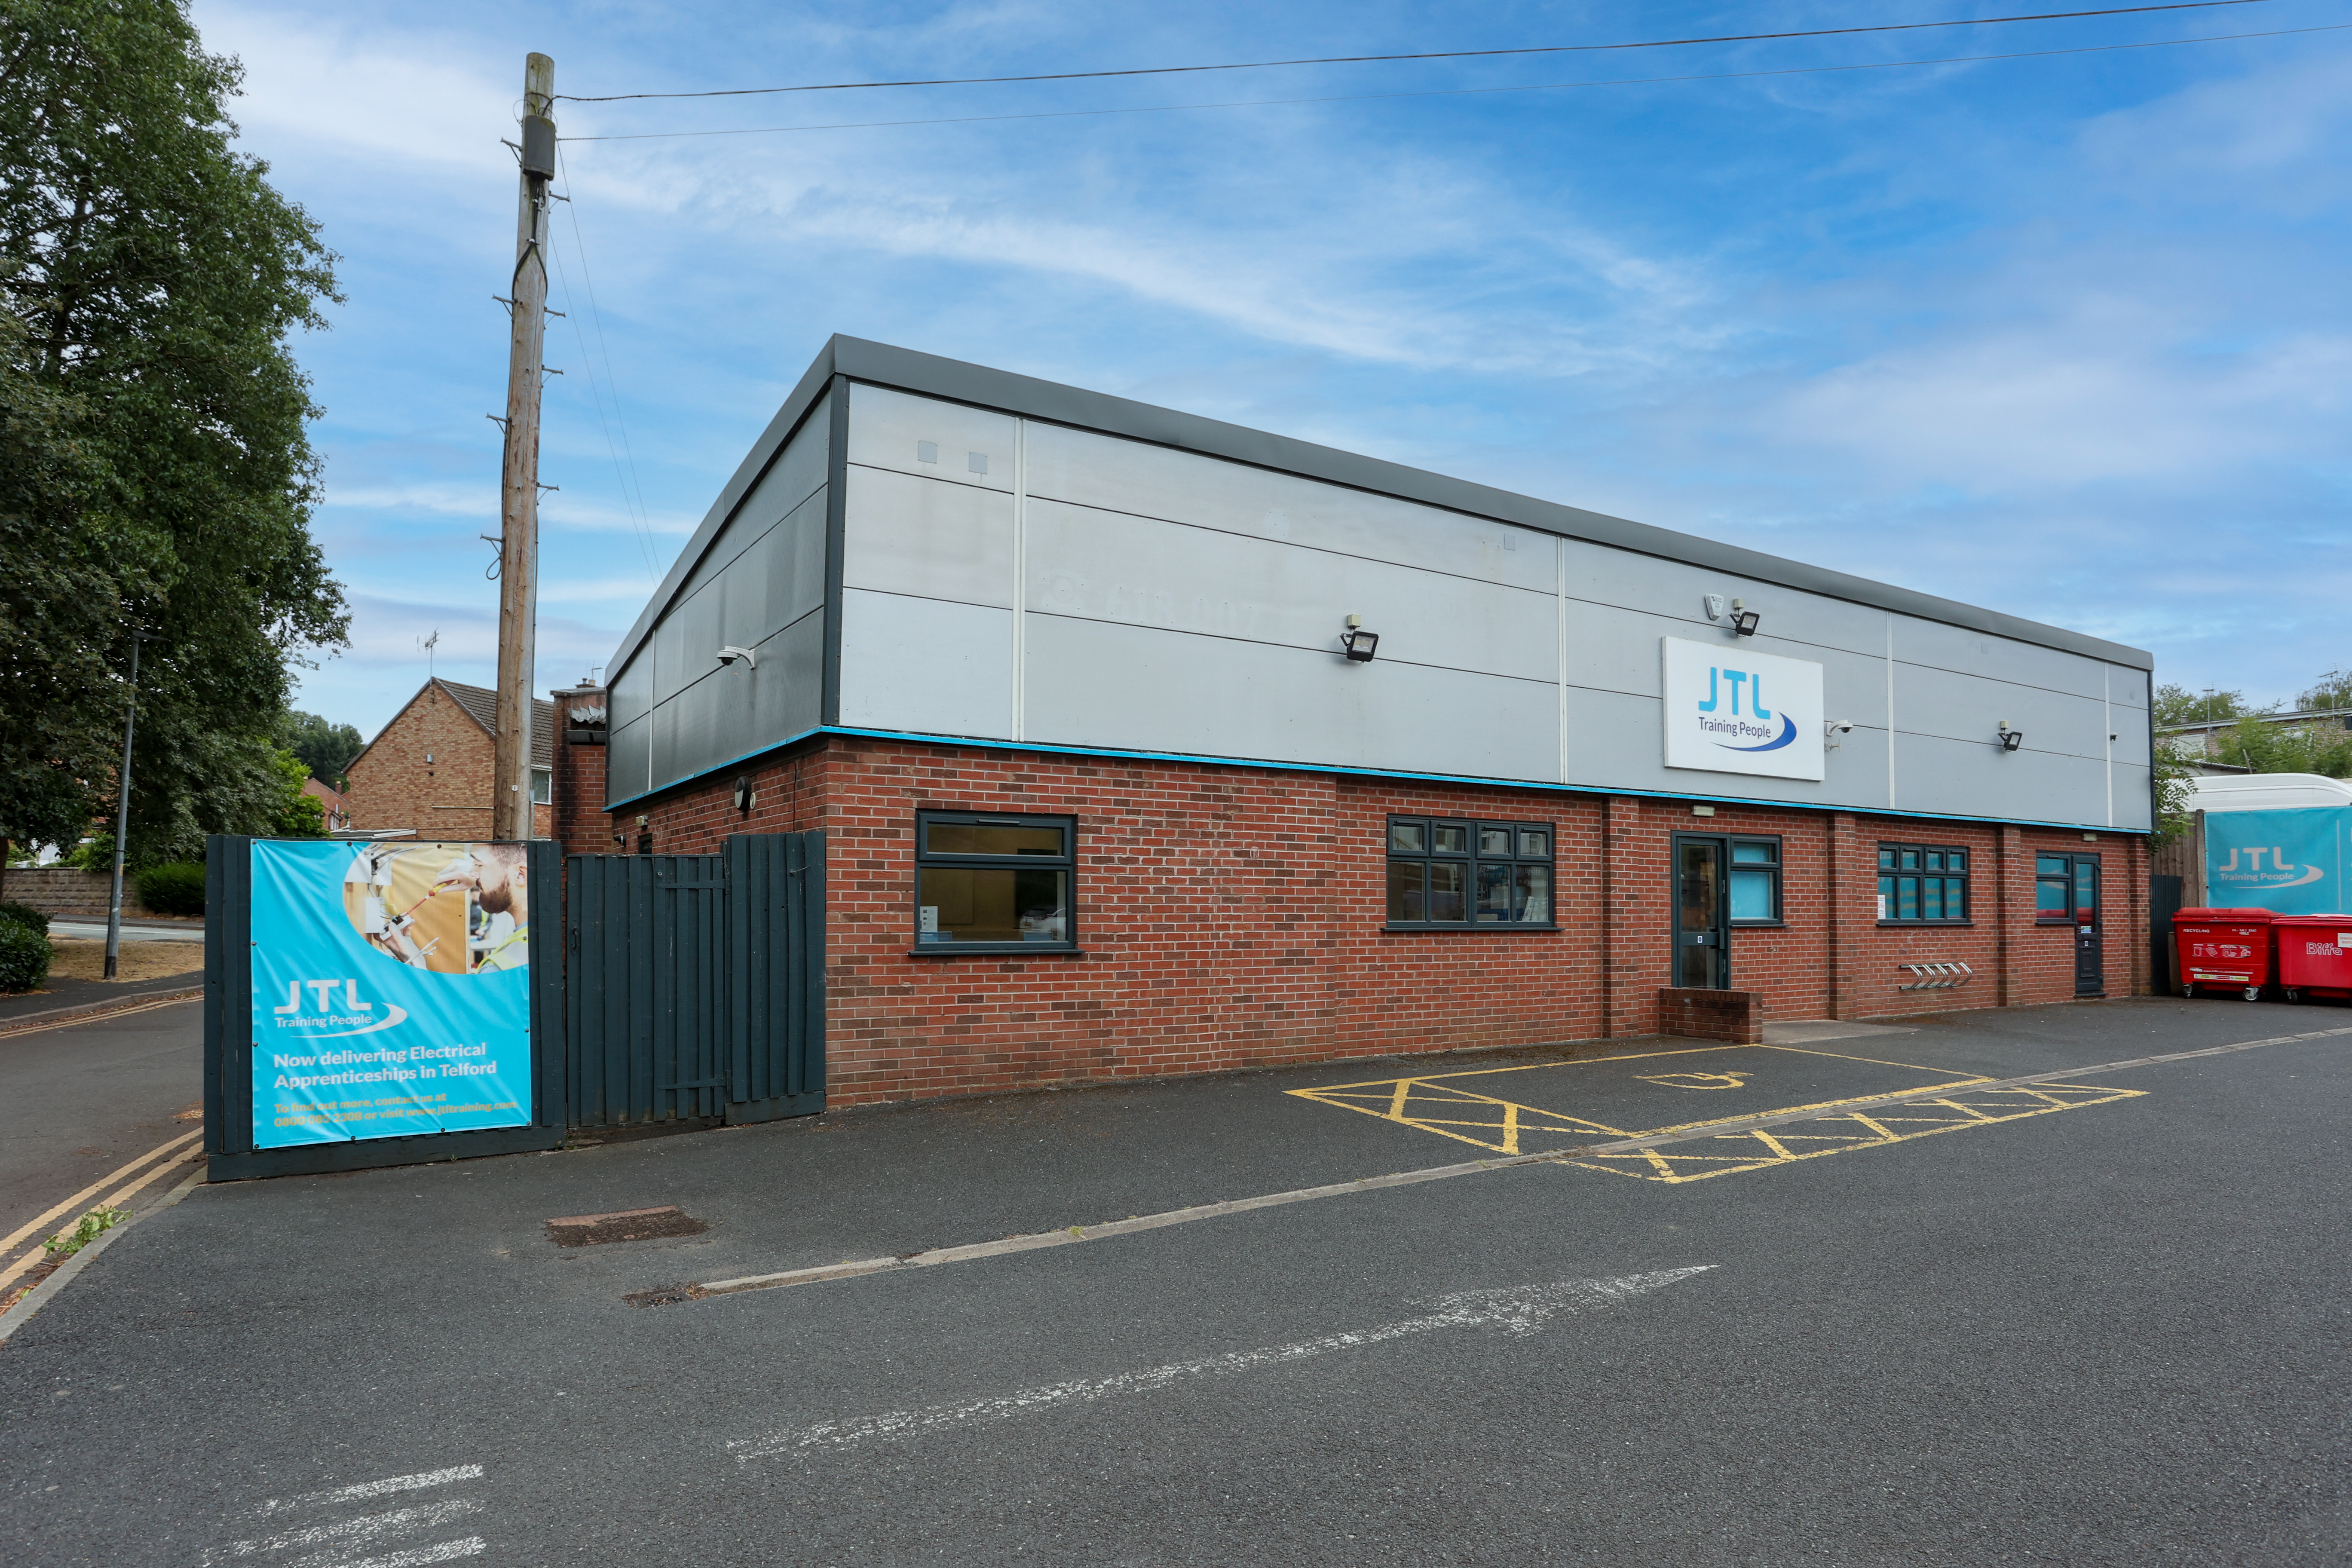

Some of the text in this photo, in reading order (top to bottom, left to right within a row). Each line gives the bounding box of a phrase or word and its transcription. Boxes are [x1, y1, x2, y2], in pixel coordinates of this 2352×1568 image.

[1698, 667, 1770, 720] JTL
[1699, 717, 1771, 739] Training People
[2219, 847, 2294, 871] JTL
[2260, 873, 2294, 881] People
[2306, 942, 2342, 956] Biffa
[274, 979, 371, 1014] JTL
[274, 1014, 371, 1028] Training People
[274, 1042, 486, 1068] Now delivering Electrical
[274, 1060, 496, 1090] Apprenticeships in Telford
[274, 1104, 289, 1113] To
[291, 1102, 315, 1112] find
[317, 1101, 337, 1110] out
[340, 1100, 373, 1109] more,
[375, 1095, 418, 1106] contact
[435, 1093, 447, 1102] at
[274, 1116, 305, 1127] 0800
[308, 1115, 330, 1124] 085
[333, 1112, 362, 1122] 2308
[380, 1109, 404, 1118] visit
[406, 1102, 517, 1116] www.jtltraining.com
